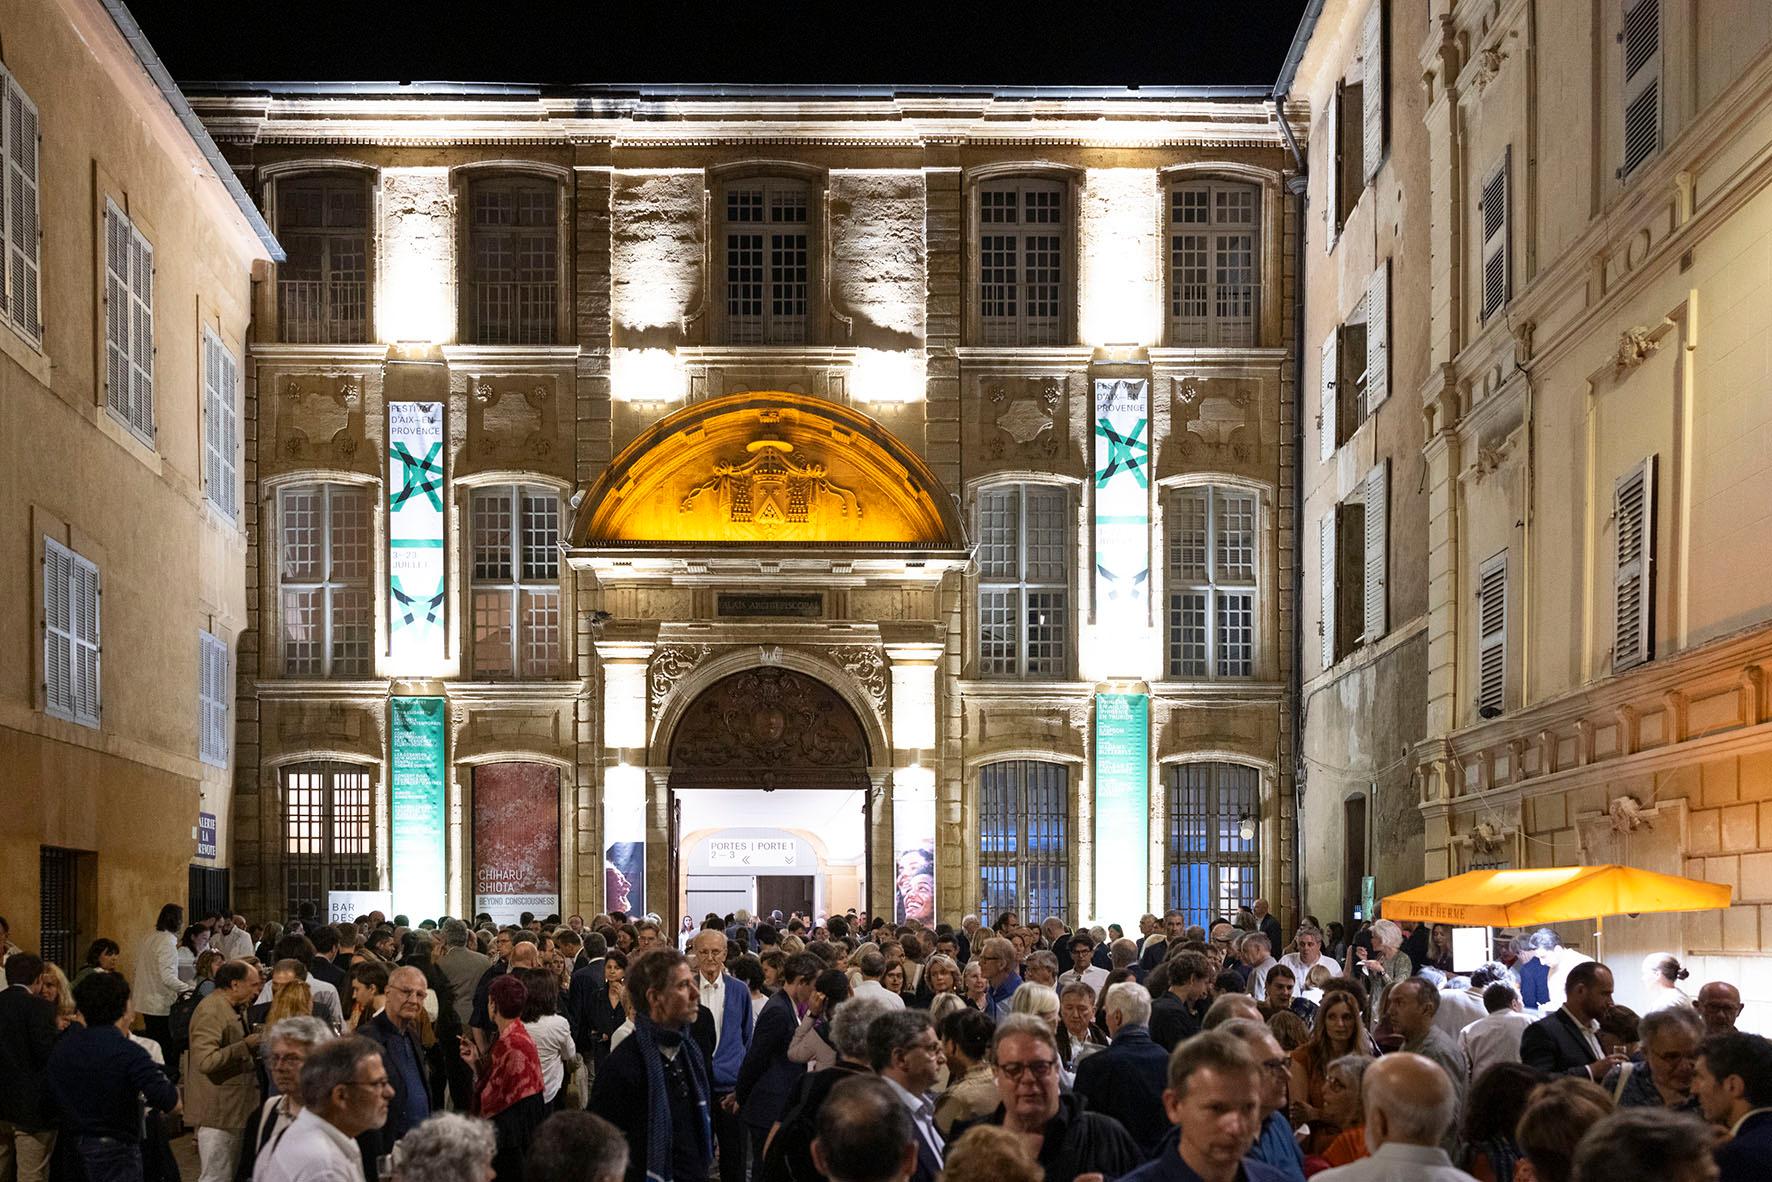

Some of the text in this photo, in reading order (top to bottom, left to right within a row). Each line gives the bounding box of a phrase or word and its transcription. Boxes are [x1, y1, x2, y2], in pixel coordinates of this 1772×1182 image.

[1096, 404, 1145, 412] PROVENCE
[391, 427, 440, 435] PROVENCE
[202, 831, 209, 842] LA
[710, 842, 747, 850] PORTES
[757, 842, 787, 850] PORTE
[478, 869, 523, 881] CHIHARU
[479, 881, 515, 893] SHIOTA
[479, 896, 555, 906] BEYOND CONSCIOUSNESS
[332, 903, 355, 911] BAR
[332, 913, 355, 922] DES
